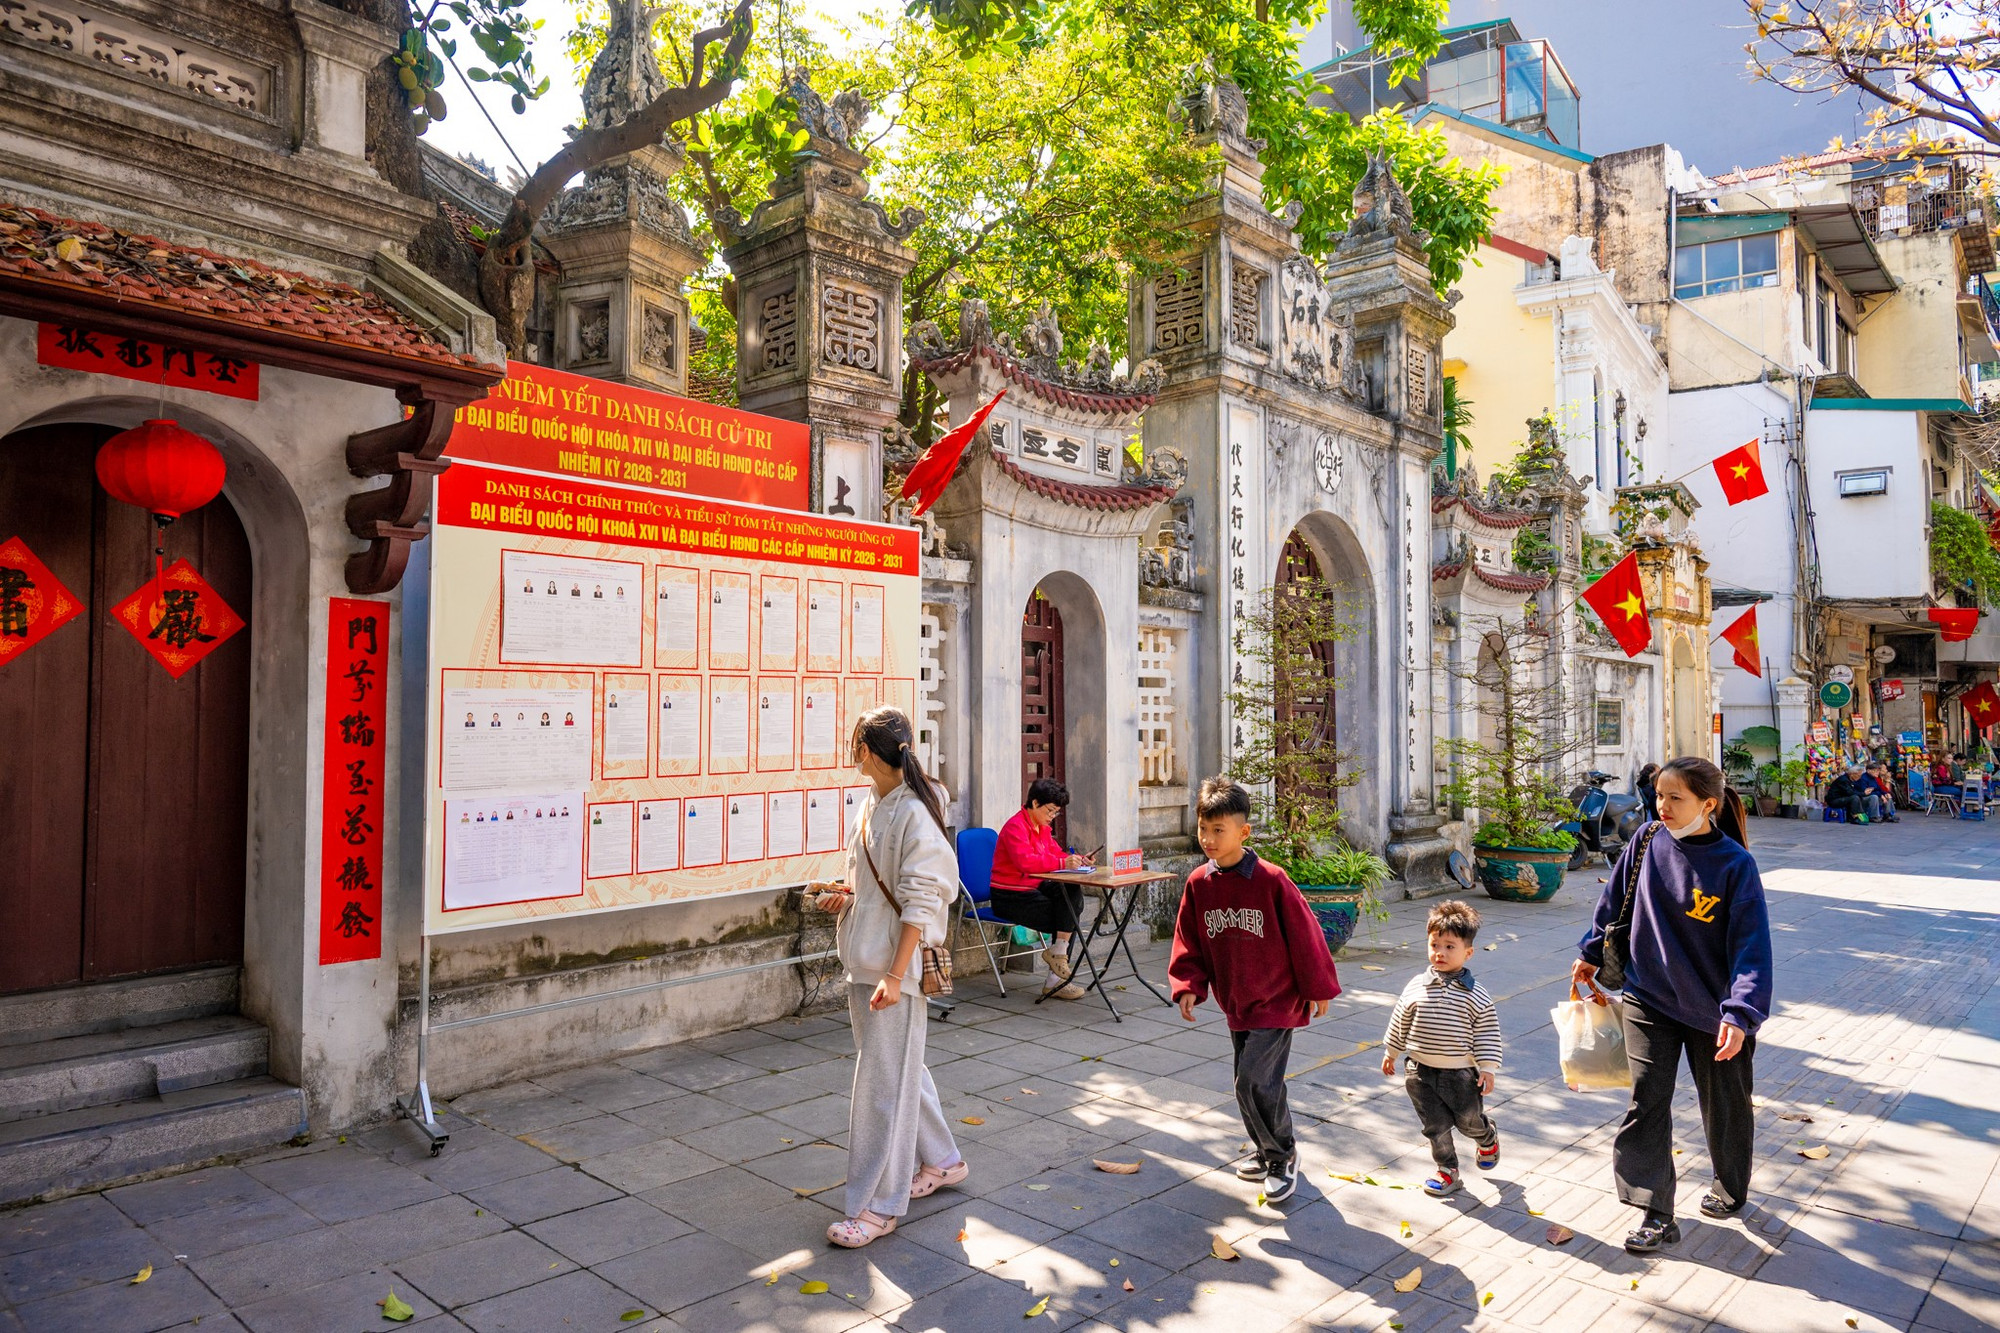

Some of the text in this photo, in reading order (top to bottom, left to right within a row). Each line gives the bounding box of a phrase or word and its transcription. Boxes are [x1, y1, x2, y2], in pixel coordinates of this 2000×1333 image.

[467, 405, 491, 431] ĐẠI
[496, 407, 527, 434] BIỂU
[532, 415, 567, 441] QUỐC
[571, 423, 592, 449] HỘI
[597, 429, 629, 453] KHÓA
[633, 436, 652, 457] XVI
[655, 438, 670, 460] VÀ
[673, 445, 692, 467] ĐẠI
[695, 444, 720, 469] BIỂU
[723, 453, 751, 474] HĐND
[754, 458, 775, 479] CÁC
[777, 460, 797, 482] CẤP
[497, 375, 772, 450] NIÊM YẾT DANH SÁCH CỬ TRI
[559, 451, 600, 476] NHIỆM
[605, 456, 621, 479] KỲ
[623, 462, 652, 482] 2026
[660, 468, 687, 489] 2031
[470, 502, 496, 524] ĐẠI
[500, 501, 532, 526] BIỂU
[536, 508, 573, 531] QUỐC
[577, 514, 598, 537] HỘI
[602, 519, 636, 539] KHOÁ
[639, 524, 658, 541] XVI
[662, 524, 677, 543] VÀ
[680, 528, 699, 548] ĐẠI
[702, 527, 727, 549] BIỂU
[730, 535, 759, 552] HĐND
[762, 537, 782, 555] CÁC
[785, 538, 804, 557] CẤP
[807, 544, 838, 563] NHIỆM
[840, 546, 852, 562] KỲ
[854, 551, 875, 565] 2026
[883, 554, 902, 568] 2031
[485, 480, 895, 547] DANH SÁCH CHÍNH THỨC VÀ TIỂU SỬ TÓM TẮT NHỮNG NGƯỜI ỨNG CỬ
[1204, 908, 1264, 938] SUMMER
